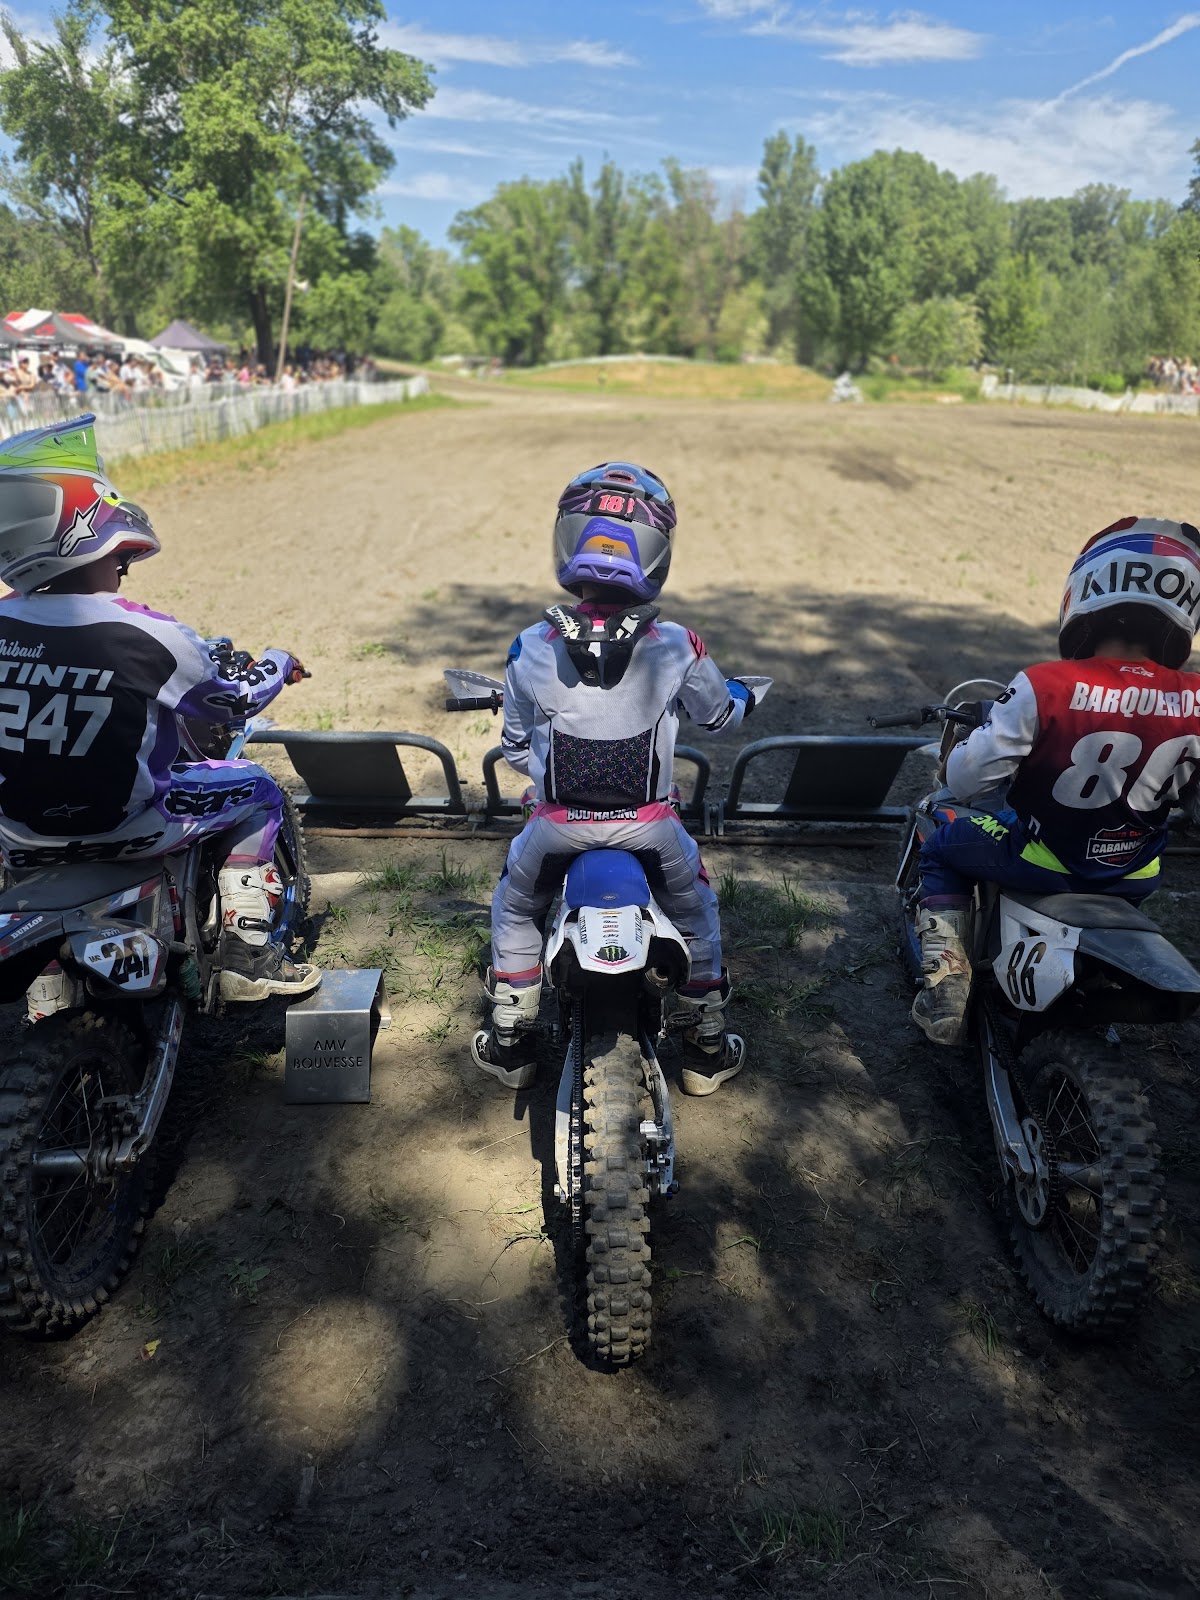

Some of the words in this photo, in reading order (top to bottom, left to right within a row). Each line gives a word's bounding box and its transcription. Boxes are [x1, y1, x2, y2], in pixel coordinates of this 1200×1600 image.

[0, 639, 46, 658] hibaut
[0, 687, 114, 757] 247
[1052, 731, 1200, 812] 86
[11, 915, 44, 939] DUNLOP
[1007, 941, 1047, 1007] 86
[313, 1040, 347, 1051] AMV
[293, 1056, 363, 1070] BOUVESSE
